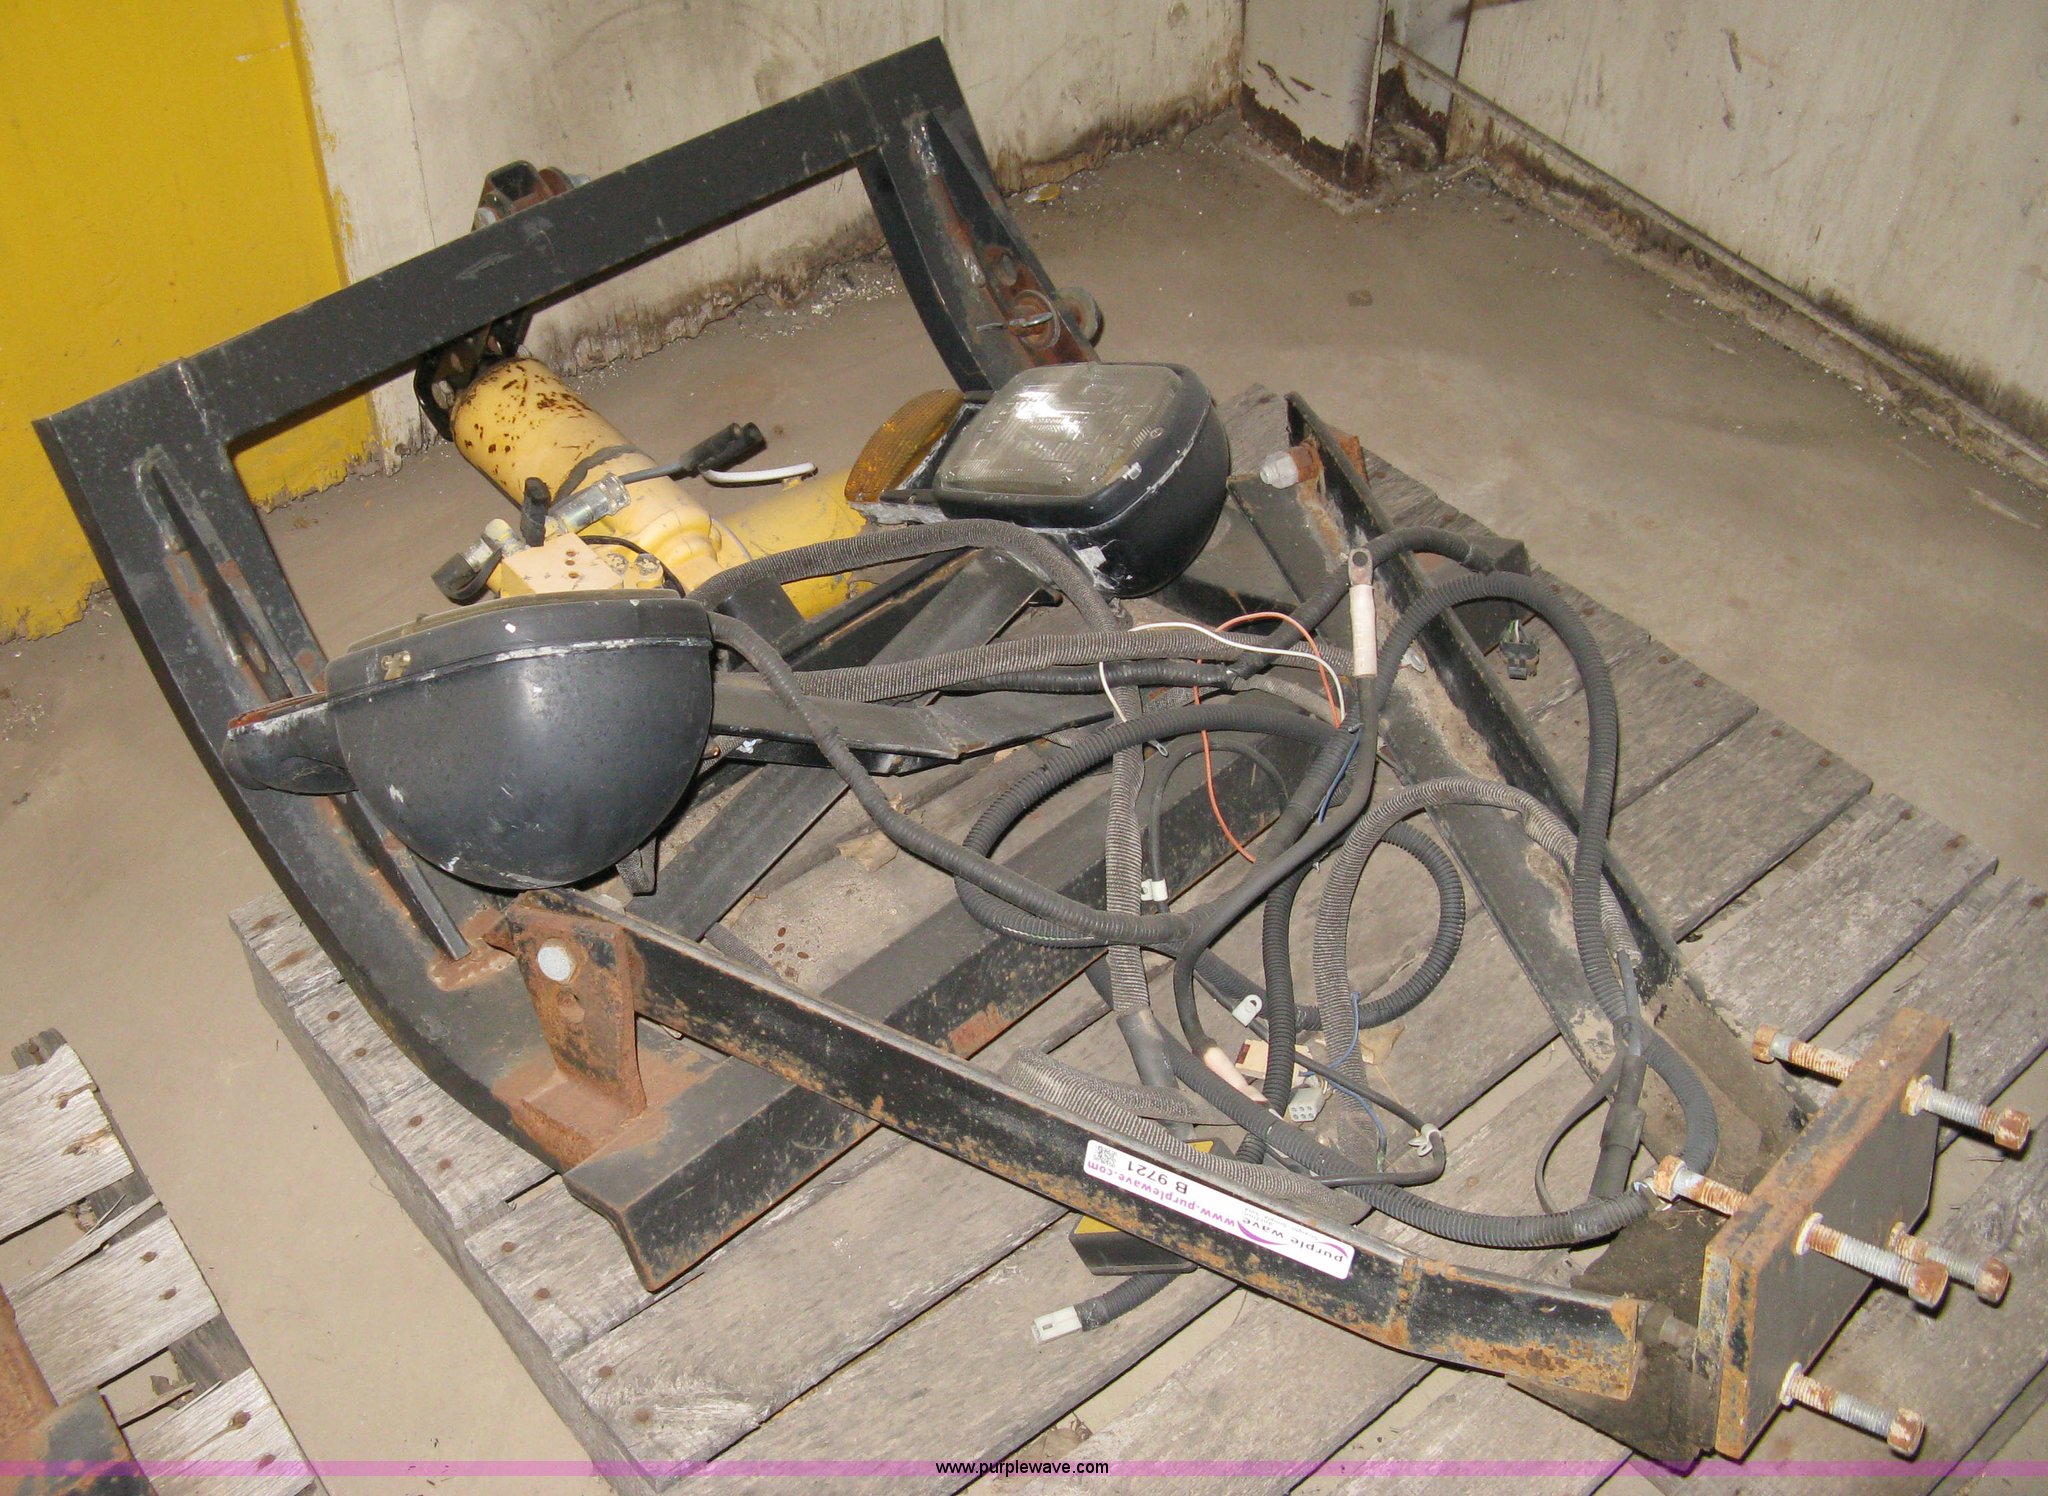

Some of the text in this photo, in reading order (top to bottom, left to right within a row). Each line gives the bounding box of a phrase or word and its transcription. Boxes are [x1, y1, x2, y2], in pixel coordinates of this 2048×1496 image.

[1087, 1160, 1235, 1226] www.purplewave.com
[1127, 1160, 1188, 1195] B 9721
[1242, 1217, 1343, 1263] purple wave
